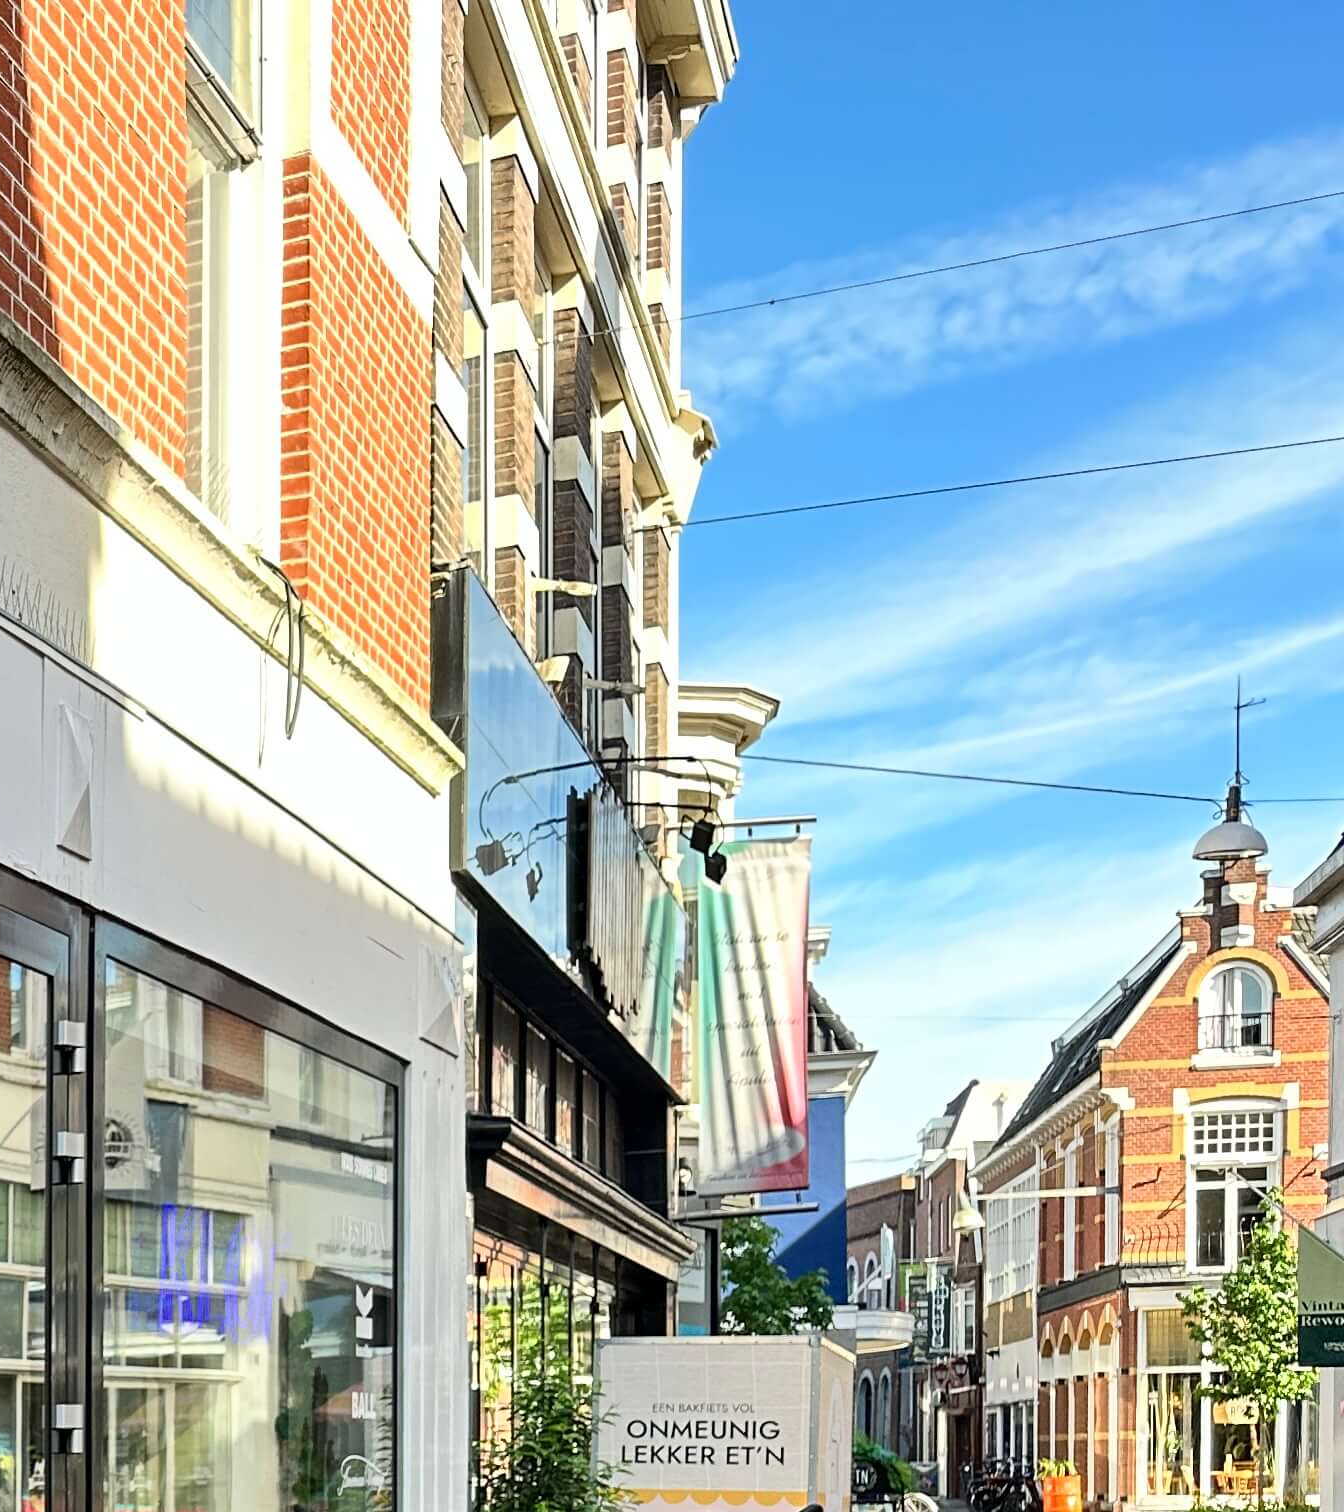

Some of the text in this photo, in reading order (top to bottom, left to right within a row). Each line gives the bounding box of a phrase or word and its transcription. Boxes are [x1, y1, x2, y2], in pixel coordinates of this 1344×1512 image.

[652, 1403, 755, 1414] EEN BAKFIETS VOL
[627, 1419, 781, 1440] ONMEUNIG
[621, 1445, 785, 1466] LEKKER ET'N
